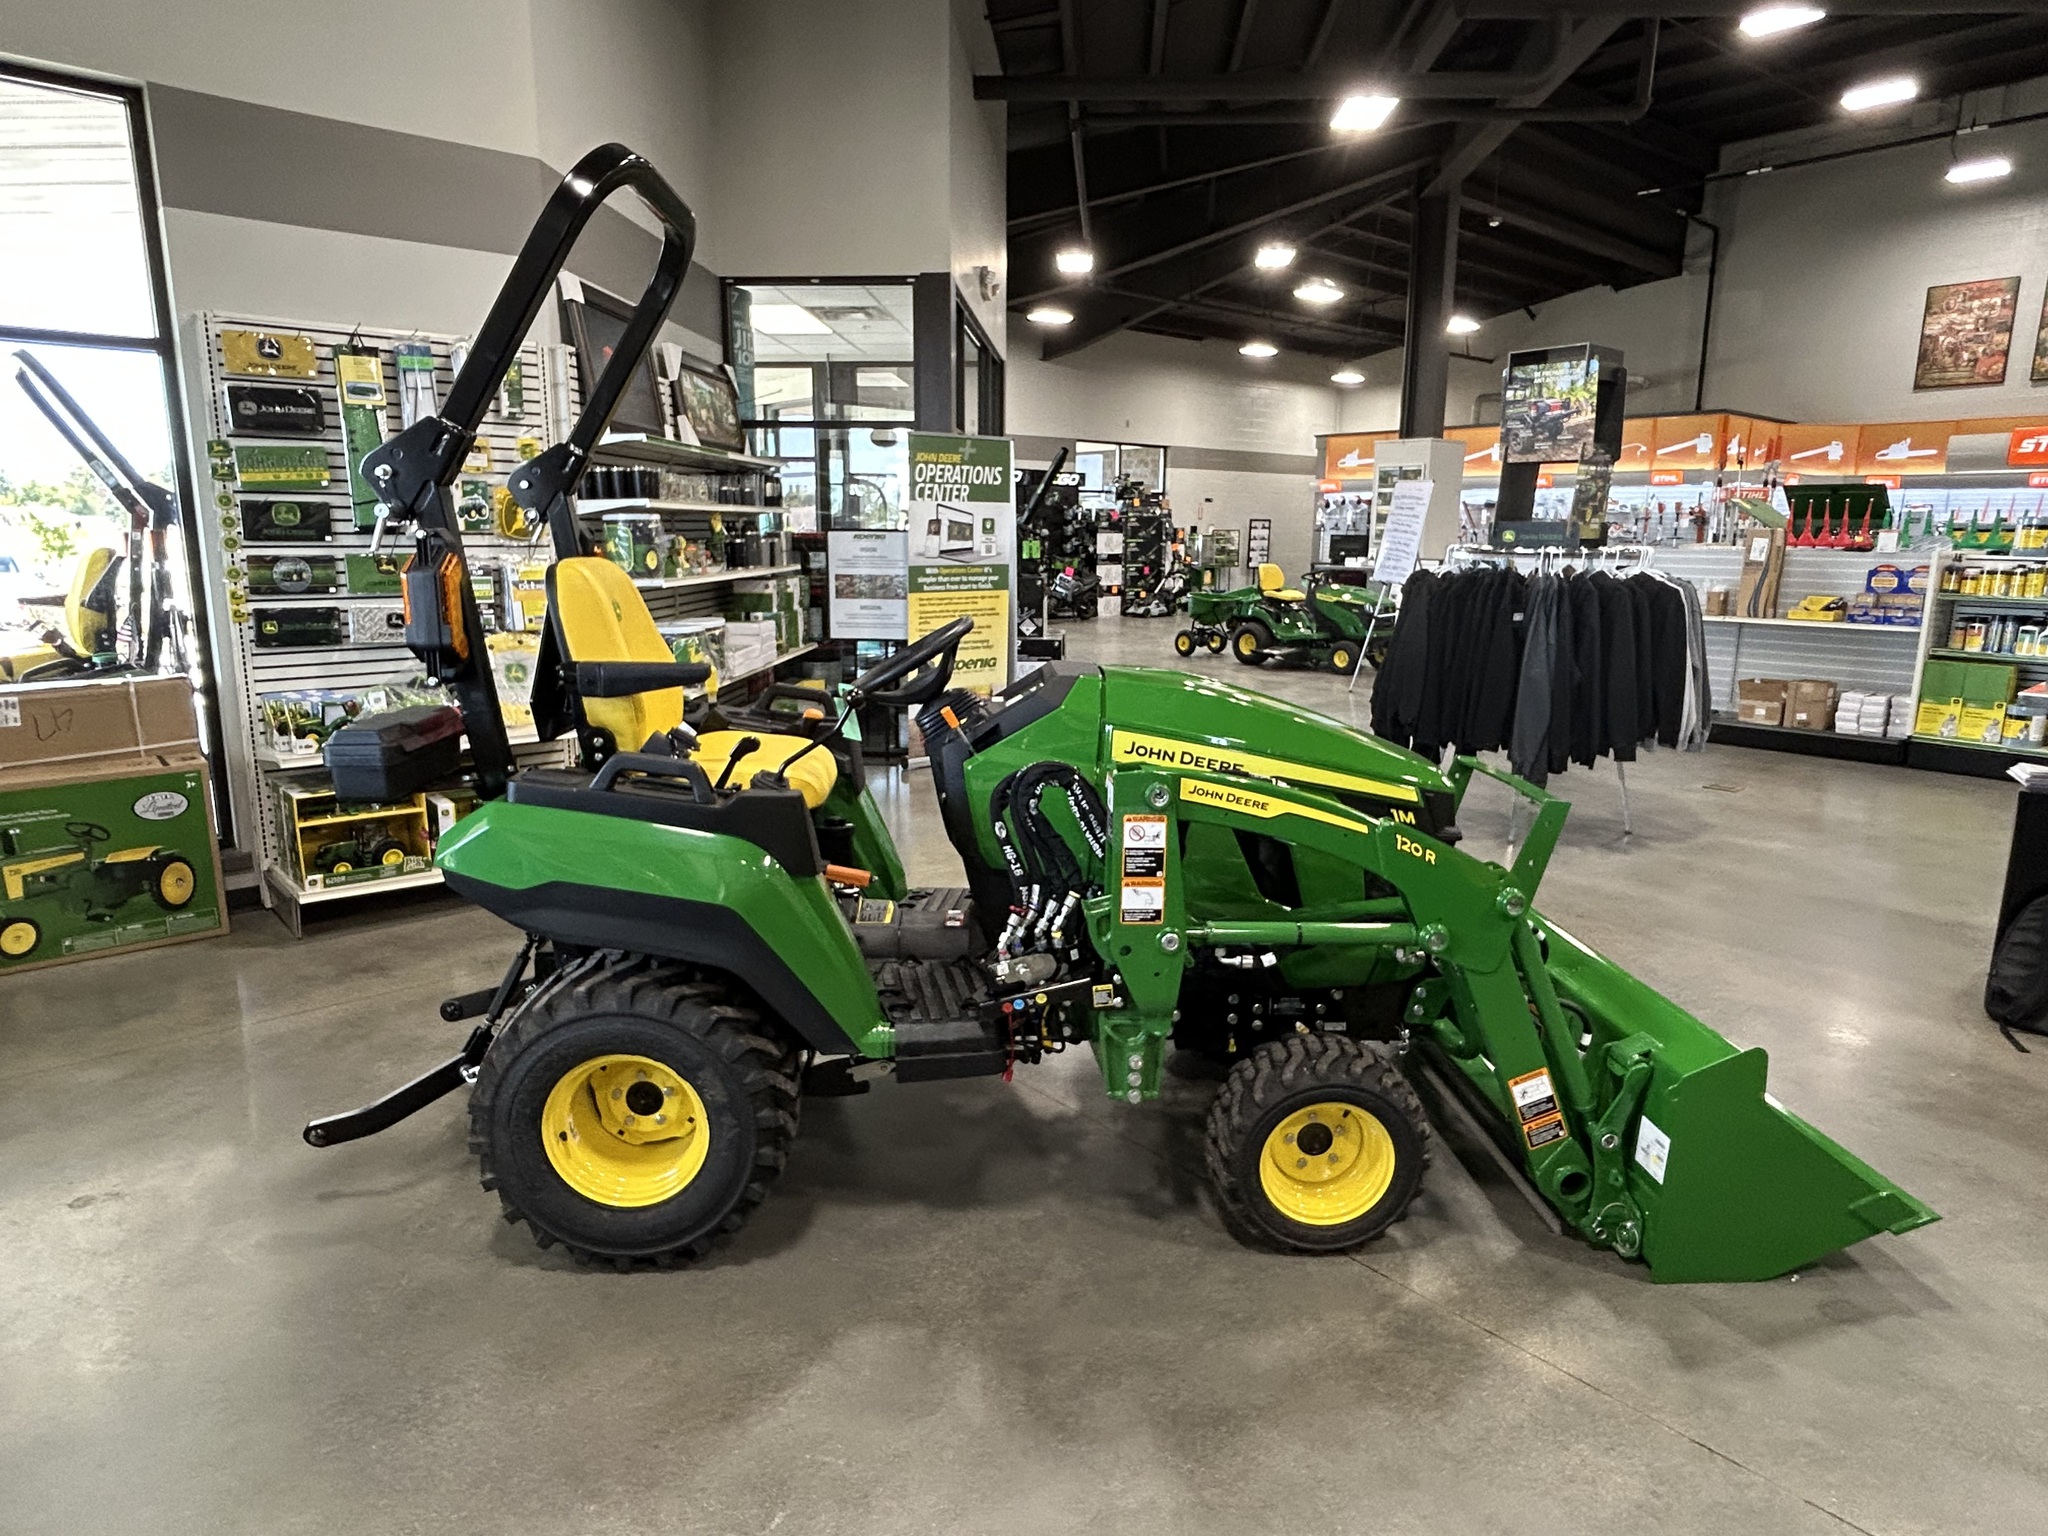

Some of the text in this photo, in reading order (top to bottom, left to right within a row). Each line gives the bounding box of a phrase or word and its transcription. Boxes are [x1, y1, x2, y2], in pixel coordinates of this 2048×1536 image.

[915, 452, 962, 463] JOHN DEERE
[915, 463, 1003, 485] OPERATIONS
[1653, 475, 1679, 483] STIHL
[915, 483, 970, 502] CENTER
[1124, 741, 1244, 772] JOHN DEERE
[1188, 785, 1270, 811] JOHN DEERE
[1390, 808, 1416, 825] 1M
[1395, 833, 1437, 865] 120 R
